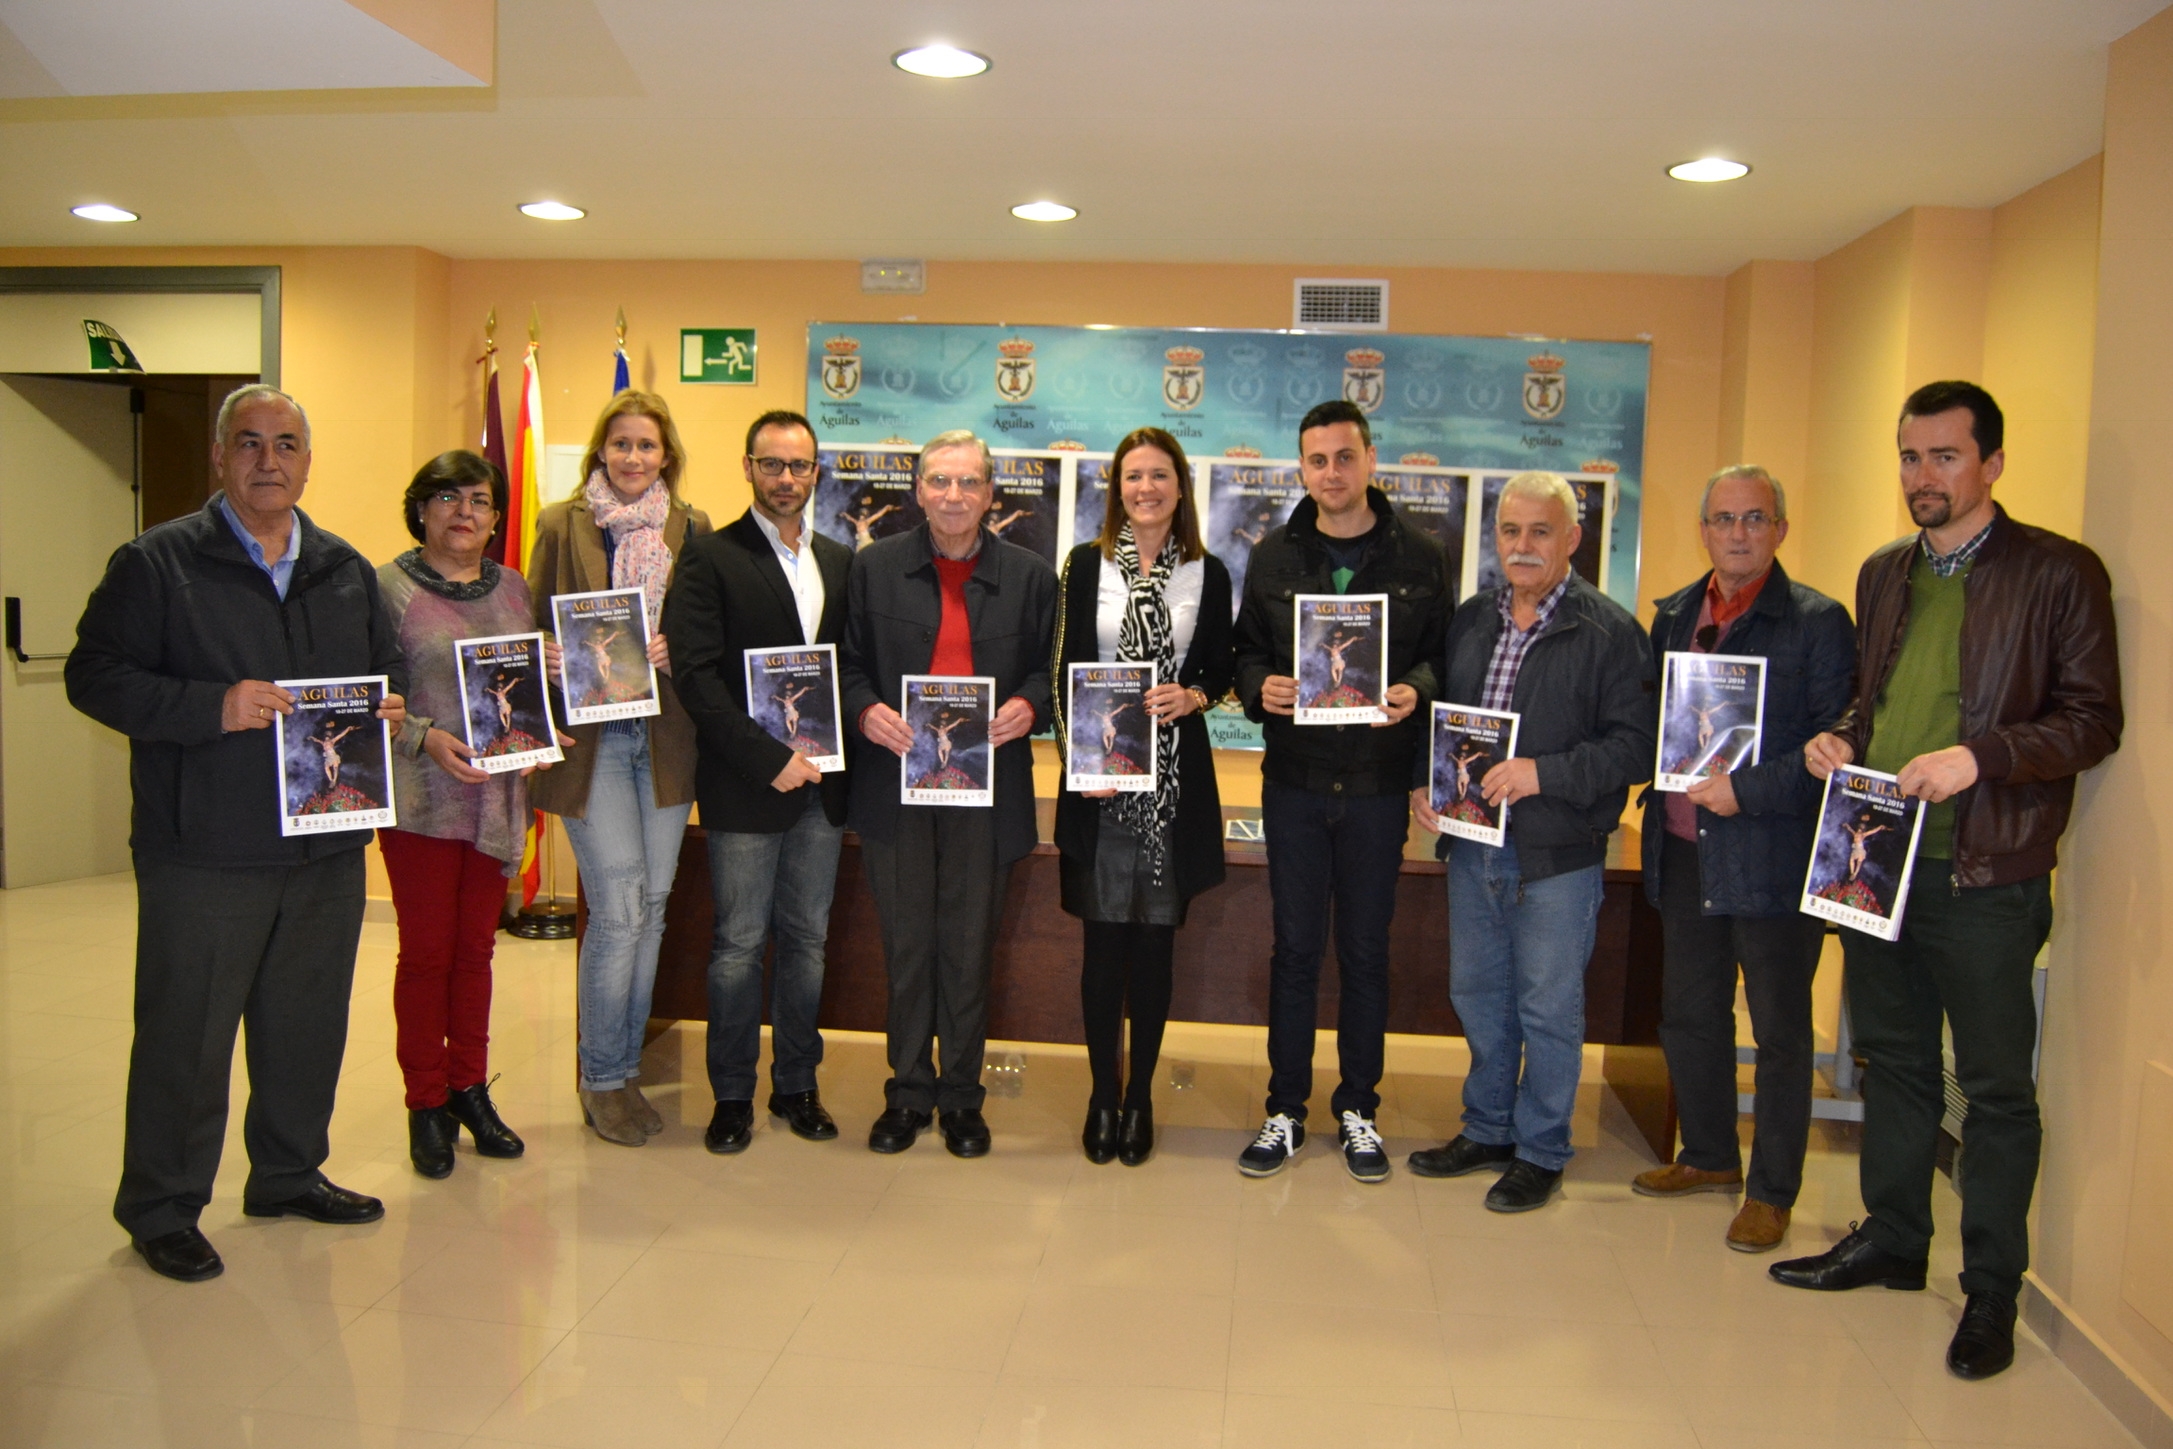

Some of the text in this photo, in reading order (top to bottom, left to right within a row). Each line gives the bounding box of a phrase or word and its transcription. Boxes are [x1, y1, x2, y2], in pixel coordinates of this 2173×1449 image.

[992, 460, 1044, 475] UILAS
[832, 471, 912, 482] Semana Santa 2016
[995, 477, 1044, 486] Santa 2016
[1400, 494, 1424, 503] Santa
[1426, 496, 1450, 505] 2016
[298, 702, 326, 710] Semana
[349, 699, 369, 707] 2016
[1228, 721, 1236, 729] de
[1842, 788, 1906, 810] Semana Santa 2016
